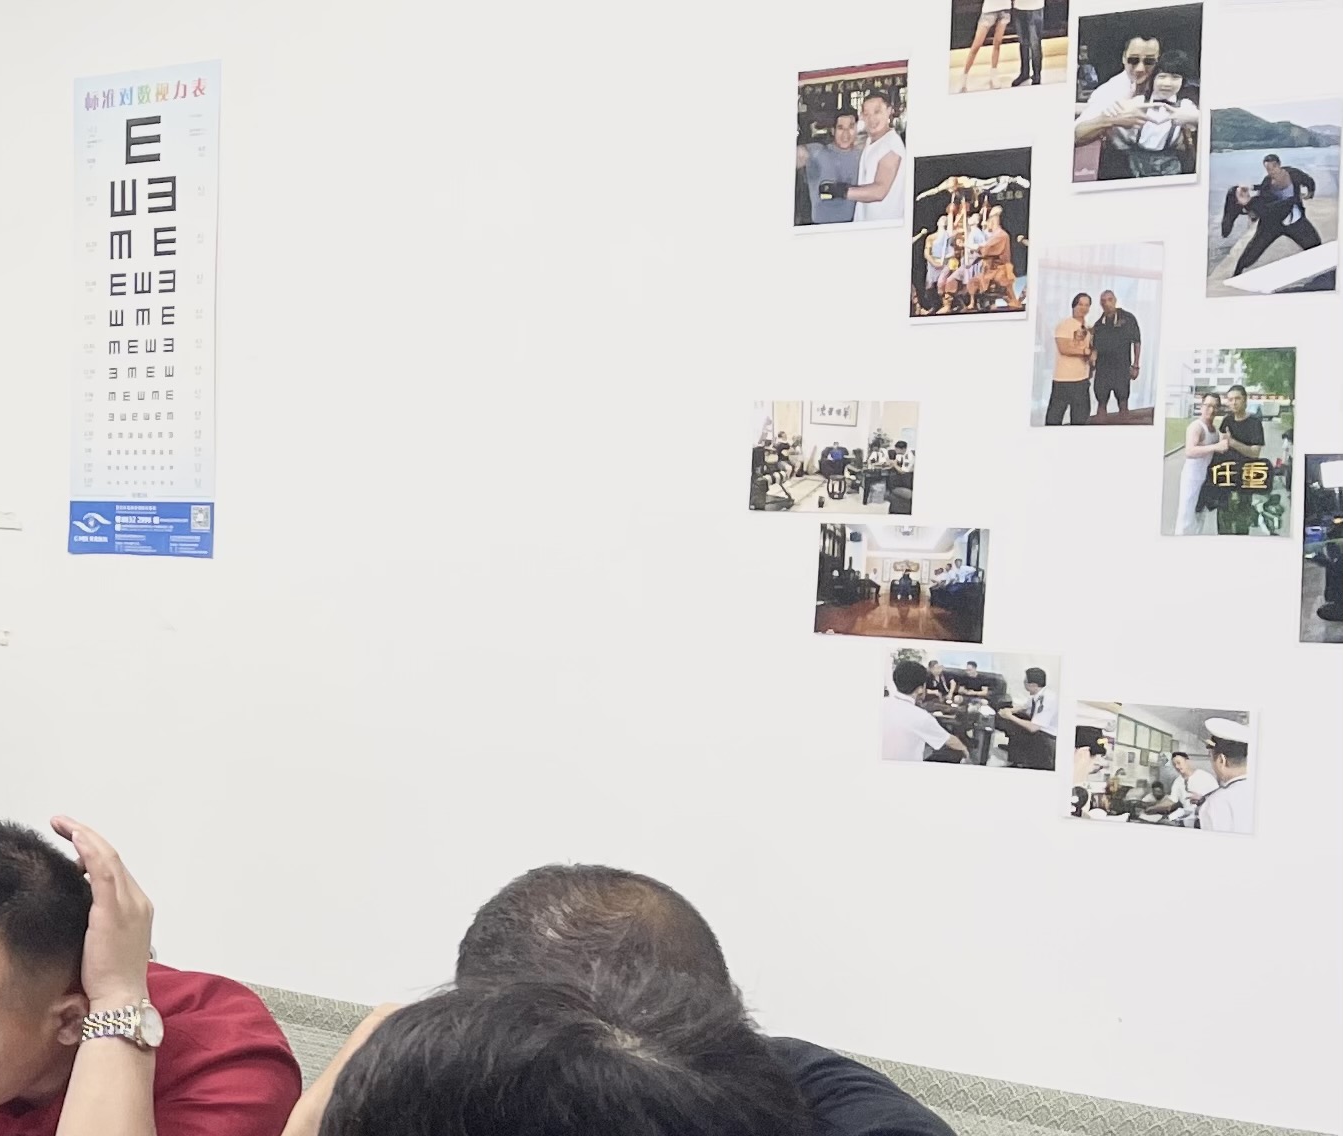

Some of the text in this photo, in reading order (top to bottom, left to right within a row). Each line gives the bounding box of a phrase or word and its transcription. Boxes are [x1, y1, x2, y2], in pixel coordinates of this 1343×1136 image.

[84, 78, 206, 111] 标准对数视力表
[1211, 461, 1270, 489] 任重
